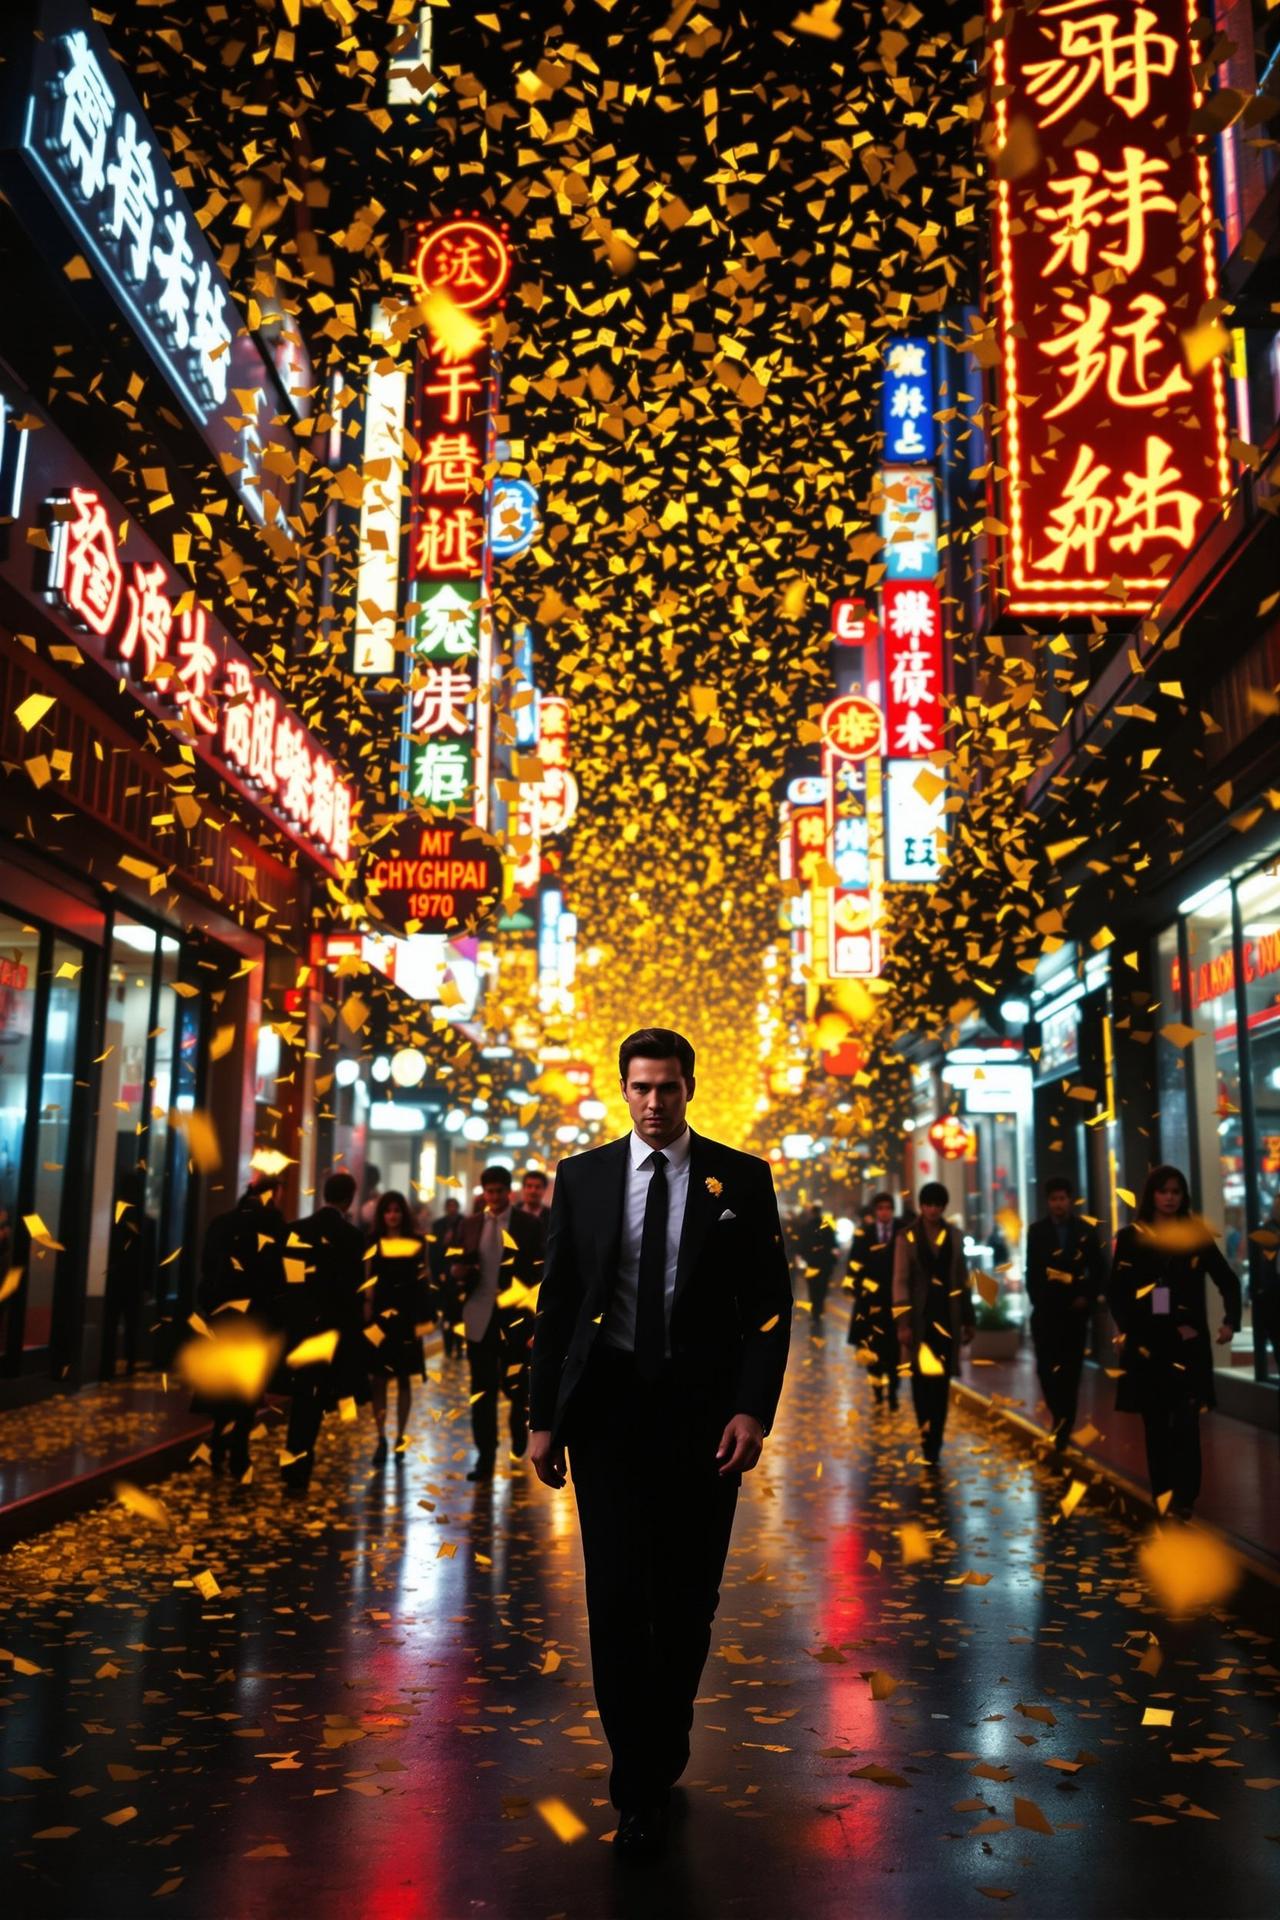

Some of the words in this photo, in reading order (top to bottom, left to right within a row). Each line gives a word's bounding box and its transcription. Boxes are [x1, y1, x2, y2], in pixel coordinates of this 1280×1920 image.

[420, 831, 454, 856] MT
[374, 860, 487, 890] CHYGHPAI
[408, 893, 455, 918] 1970
